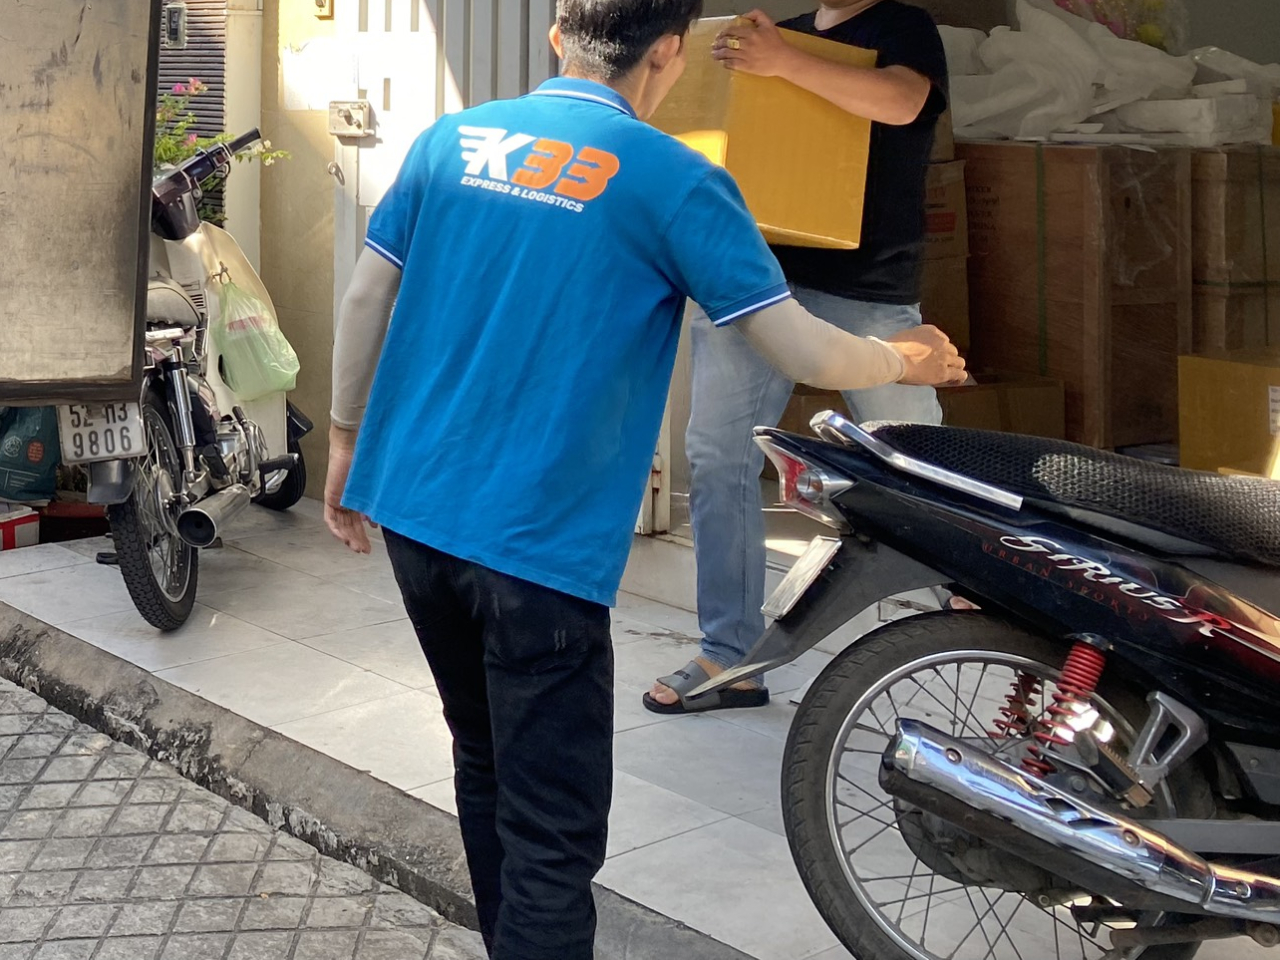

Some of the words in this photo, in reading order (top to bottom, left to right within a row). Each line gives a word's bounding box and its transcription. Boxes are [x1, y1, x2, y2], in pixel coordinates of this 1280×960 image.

[460, 175, 512, 194] EXPRESS
[511, 185, 521, 197] &
[520, 189, 585, 213] LOGISTICS
[73, 426, 132, 458] 9806
